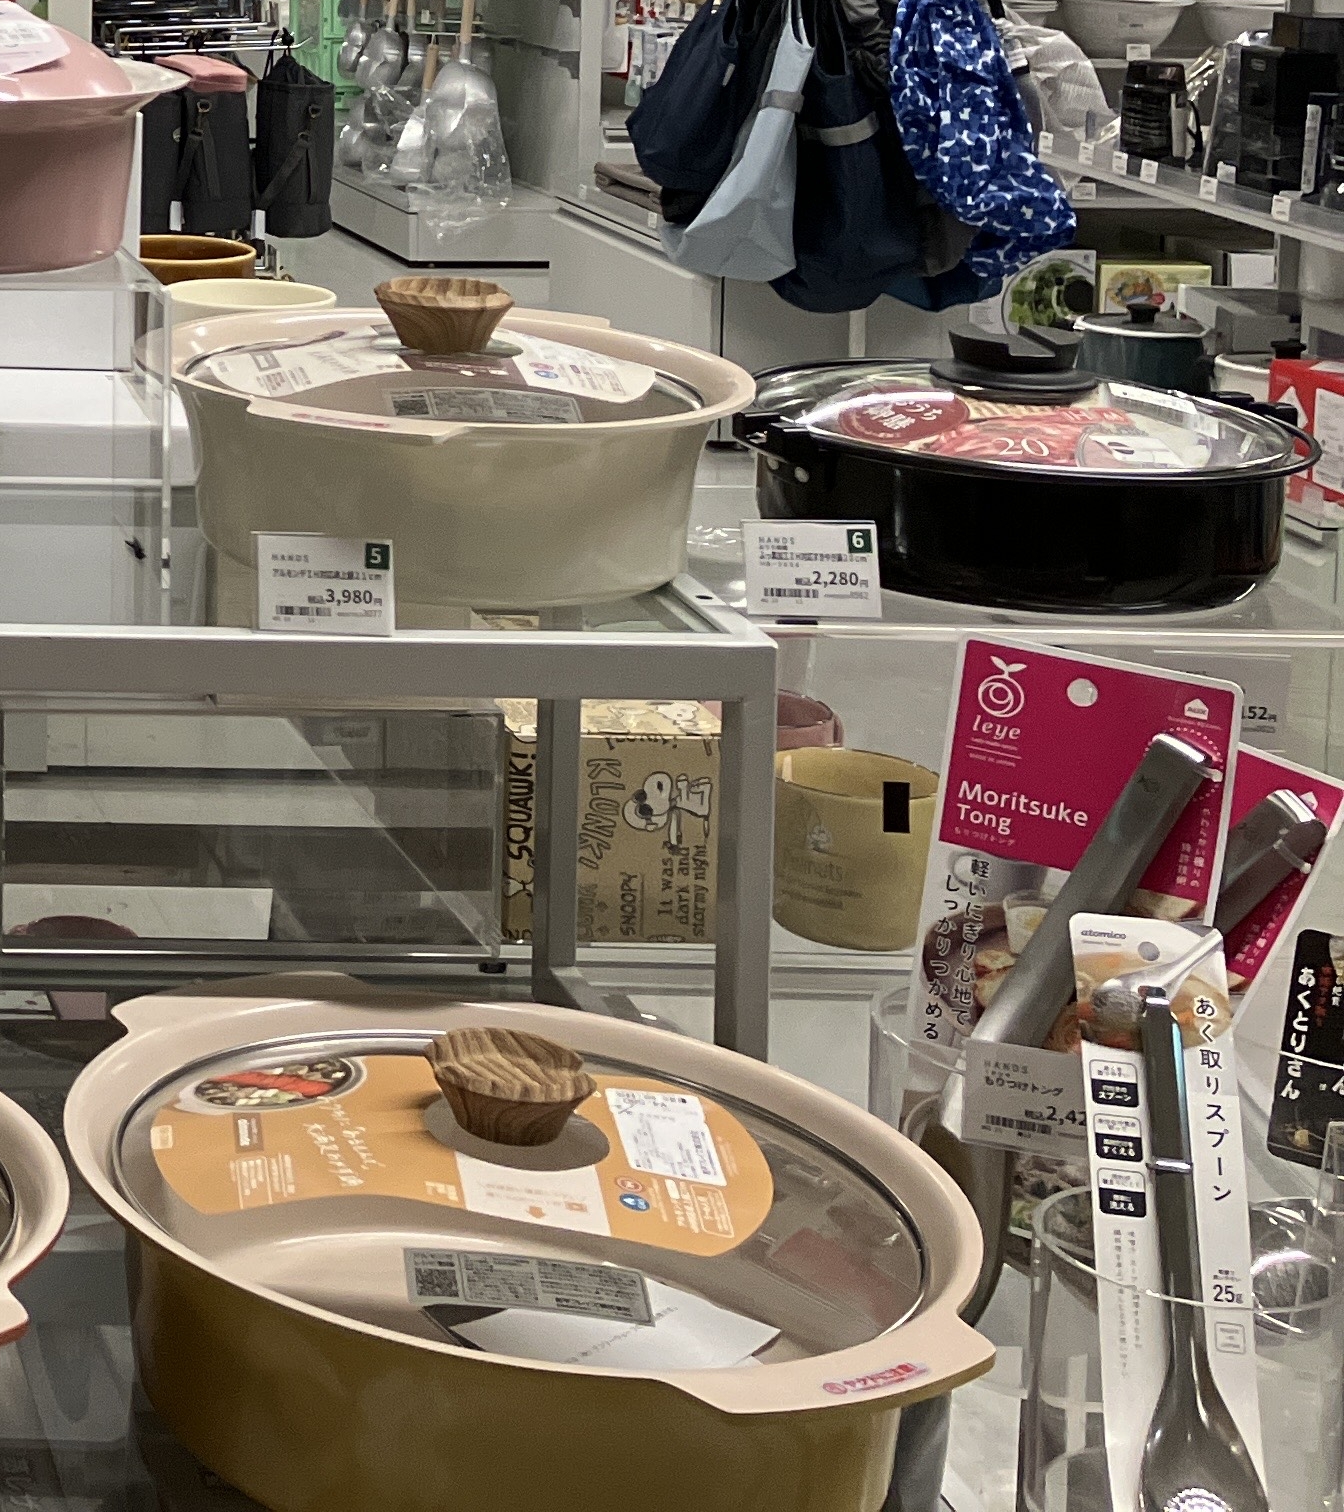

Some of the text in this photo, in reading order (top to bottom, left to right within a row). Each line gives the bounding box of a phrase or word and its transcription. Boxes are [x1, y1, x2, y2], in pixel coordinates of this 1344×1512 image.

[998, 438, 1050, 457] 20
[370, 548, 382, 564] 5
[759, 537, 795, 545] HANDS
[852, 532, 864, 548] 6
[271, 554, 310, 563] HANDS
[972, 714, 1020, 739] leye
[507, 751, 536, 861] SQUAWK!
[957, 803, 1011, 835] Tong
[958, 780, 1088, 827] Moritsuke
[620, 872, 637, 936] SNOOPY
[676, 886, 690, 925] dark
[951, 859, 989, 1025] 軽いにぎり心地で
[1081, 929, 1126, 941] atomico
[924, 874, 960, 1039] しっかりつかめる
[1281, 967, 1315, 1100] あくとりさん
[984, 1060, 1027, 1074] HANDS
[1194, 997, 1231, 1202] あく取りスプーン
